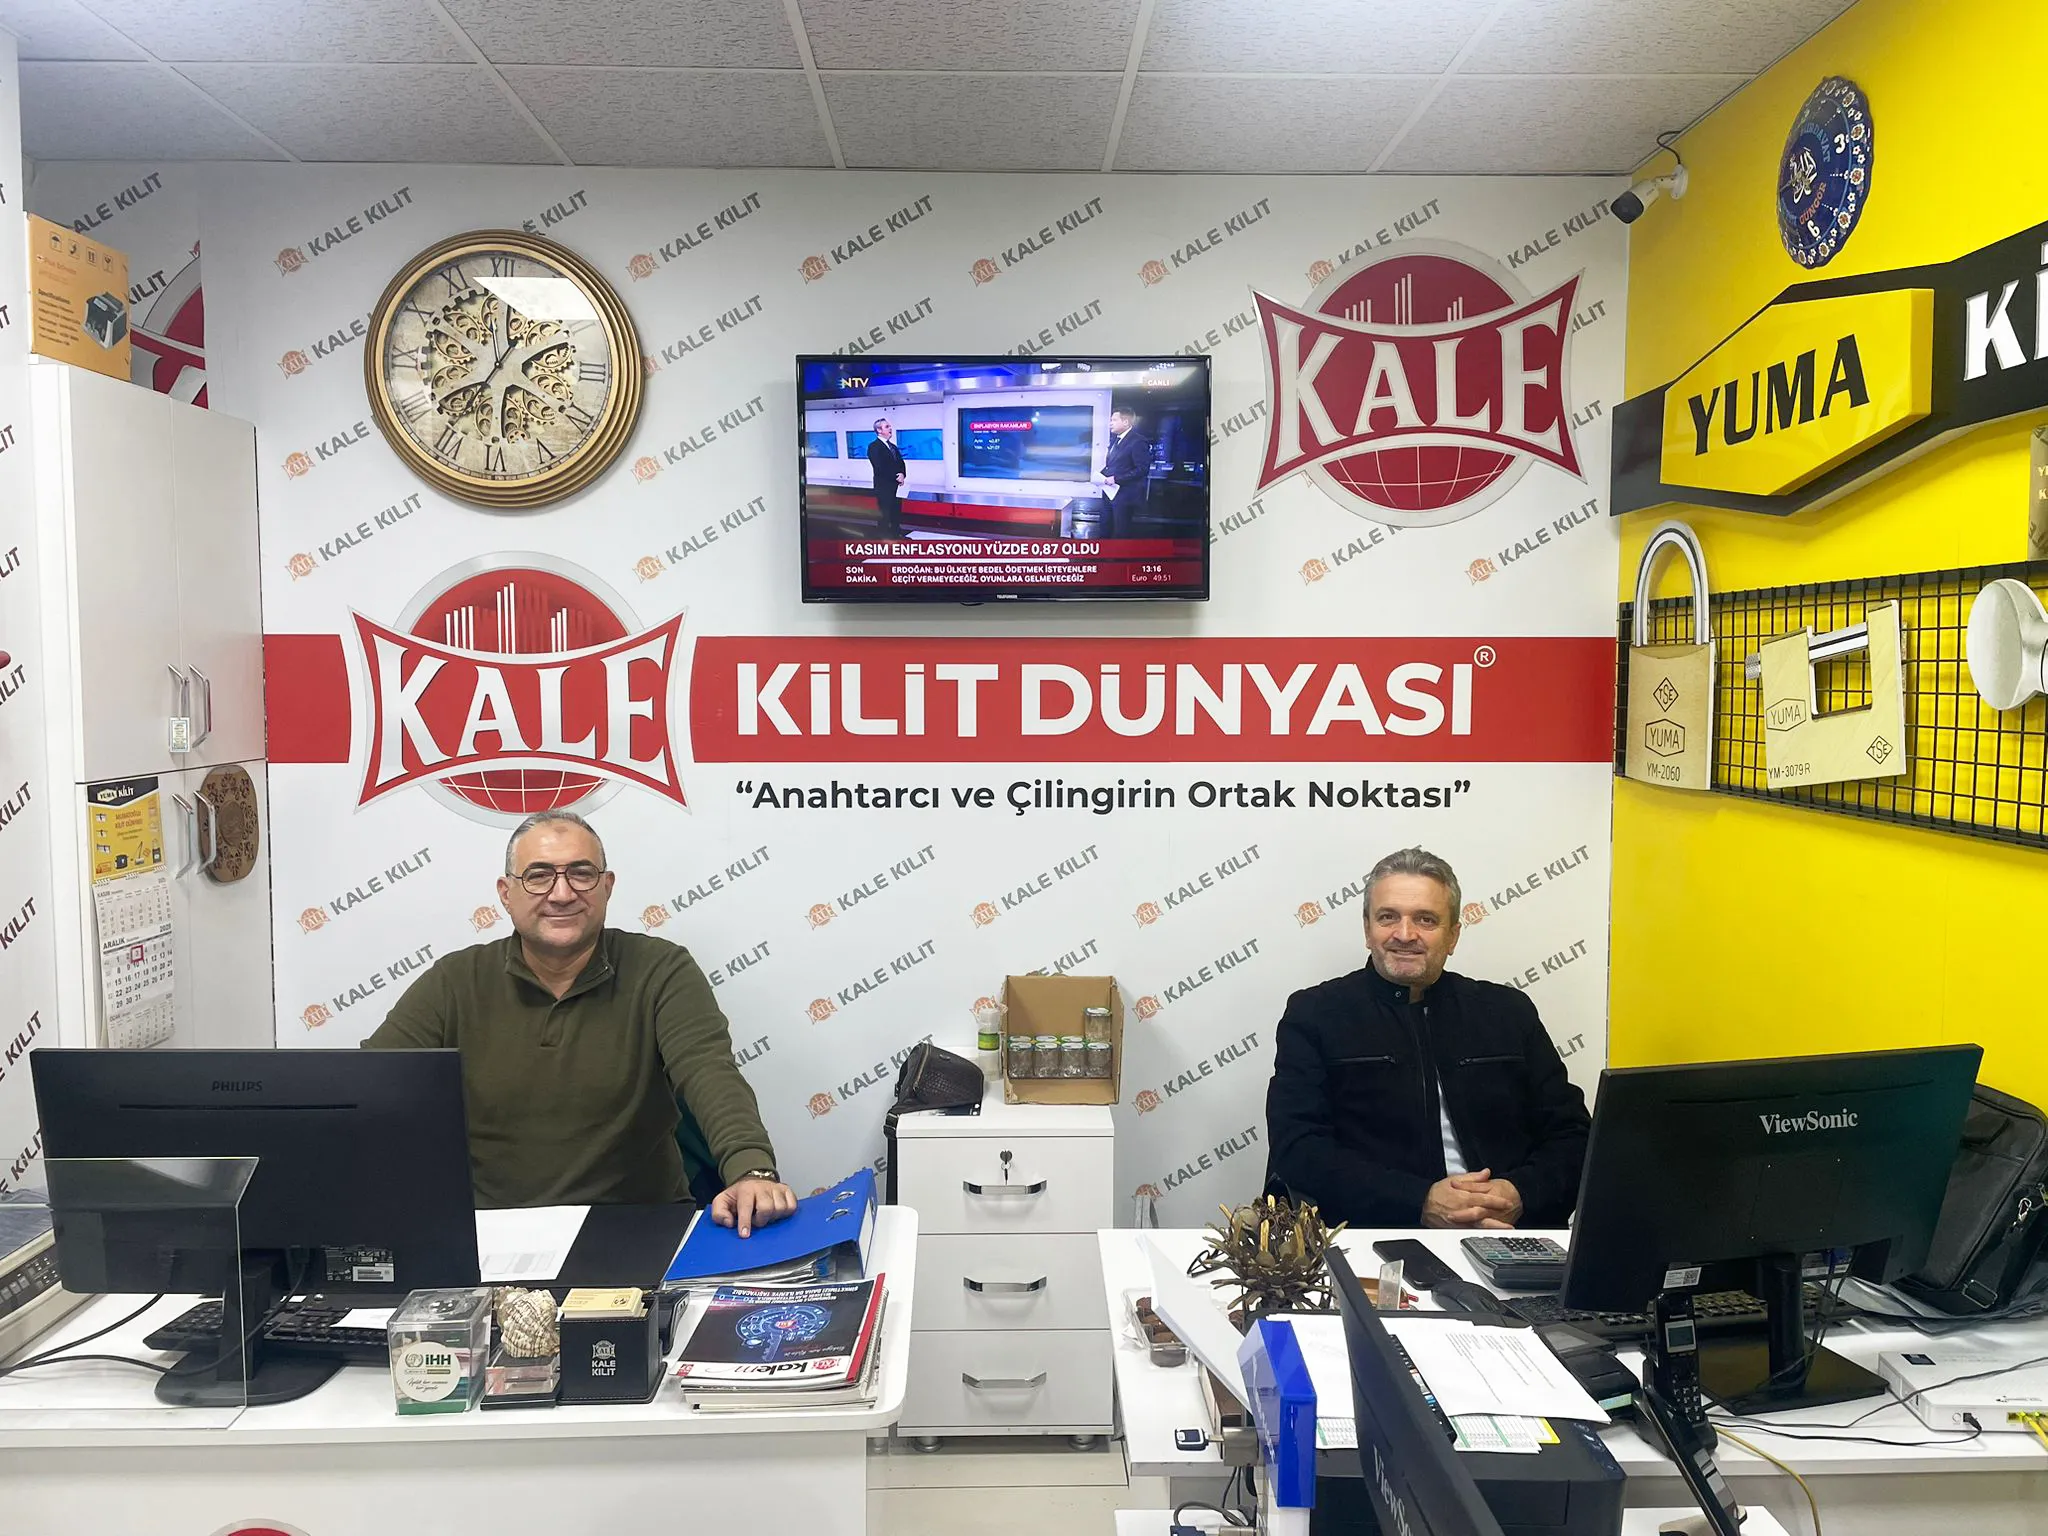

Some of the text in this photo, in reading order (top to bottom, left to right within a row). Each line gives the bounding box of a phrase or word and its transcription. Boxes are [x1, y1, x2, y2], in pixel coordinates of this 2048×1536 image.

[1834, 133, 1846, 154] 3
[73, 203, 113, 233] ALE
[307, 216, 364, 257] KALE
[1807, 220, 1820, 238] 6
[659, 222, 713, 262] KALE
[831, 225, 885, 264] KALE
[1001, 227, 1056, 266] KALE
[1170, 228, 1223, 268] KALE
[1507, 229, 1561, 269] KALE
[311, 319, 367, 359] KALE
[661, 325, 715, 364] KALE
[842, 377, 869, 388] NTV
[1273, 299, 1565, 469] KALE
[1688, 334, 1870, 455] YUMA
[315, 421, 370, 460] KALE
[663, 426, 717, 465] KALE
[318, 522, 374, 561] KALE
[665, 526, 719, 564] KALE
[845, 540, 1099, 557] KASIM ENFLASYONU YÜZDE 0,87 OLDU
[1331, 528, 1385, 566] KALE
[1498, 528, 1552, 566] KALE
[846, 575, 877, 583] DAKİKA
[891, 564, 1097, 574] ERDOĞAN: BU ÜLKEYE BEDEL ÖDETMEK İSTEYENLERE
[891, 574, 916, 585] GEÇİT
[980, 575, 1023, 583] OYUNLARA
[1024, 573, 1084, 583] GELMEYECEĞİZ
[1131, 574, 1147, 582] Euro
[1142, 565, 1161, 573] 13:16
[373, 620, 670, 788] KALE
[736, 663, 999, 737] KİLİT
[1021, 663, 1471, 737] DÜNYASI
[1770, 705, 1802, 726] YUMA
[1650, 727, 1680, 749] YUMA
[1646, 762, 1680, 782] YM-2060
[951, 789, 995, 809] ve
[1006, 780, 1175, 816] Çilingirin
[1197, 780, 1294, 809] Ortak
[329, 877, 384, 915] KALE
[671, 874, 724, 912] KALE
[837, 873, 889, 911] KALE
[1000, 872, 1052, 910] KALE
[1164, 872, 1214, 910] KALE
[1489, 873, 1542, 911] KALE
[332, 973, 386, 1012] KALE
[837, 968, 889, 1005] KALE
[1163, 967, 1213, 1003] KALE
[212, 1080, 263, 1092] PHILIPS
[837, 1063, 889, 1100] KALE
[1163, 1060, 1213, 1097] KALE
[1759, 1108, 1858, 1135] ViewSonic
[1163, 1154, 1213, 1190] KALE
